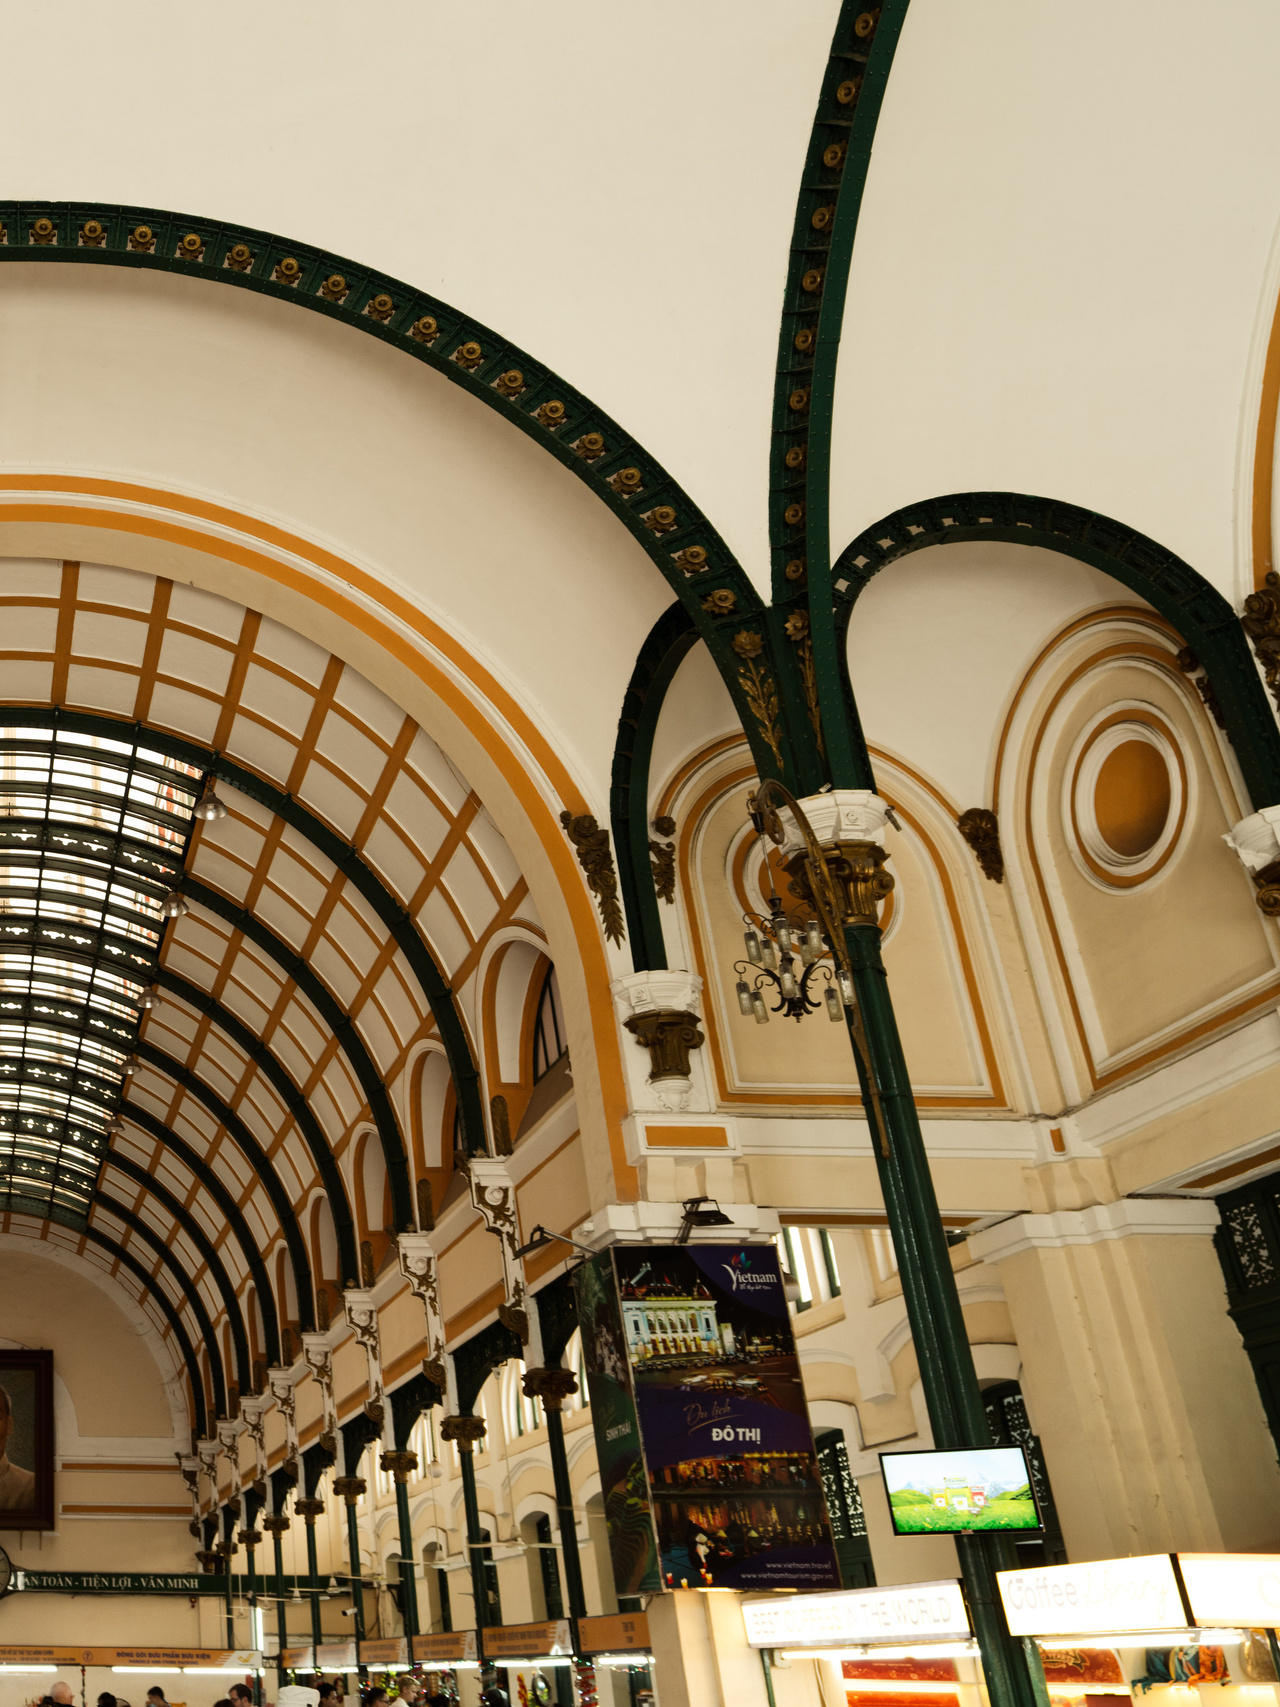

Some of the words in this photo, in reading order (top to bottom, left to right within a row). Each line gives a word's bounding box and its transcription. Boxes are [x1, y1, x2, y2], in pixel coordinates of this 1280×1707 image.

[721, 1264, 778, 1292] Vietnam
[683, 1403, 708, 1425] Du
[712, 1425, 735, 1441] ĐÔ
[736, 1428, 761, 1444] THỊ
[765, 1561, 831, 1569] www.vietnam.travel
[41, 1573, 72, 1587] TOÀN
[81, 1574, 109, 1589] TIỆN
[111, 1576, 131, 1590] LỢI
[140, 1574, 168, 1588] VĂN
[169, 1578, 199, 1589] MINH
[740, 1572, 834, 1581] www.vietnamtourism.gov.vn
[1007, 1576, 1078, 1610] Coffee
[860, 1602, 891, 1627] THE
[892, 1597, 951, 1625] WORLD
